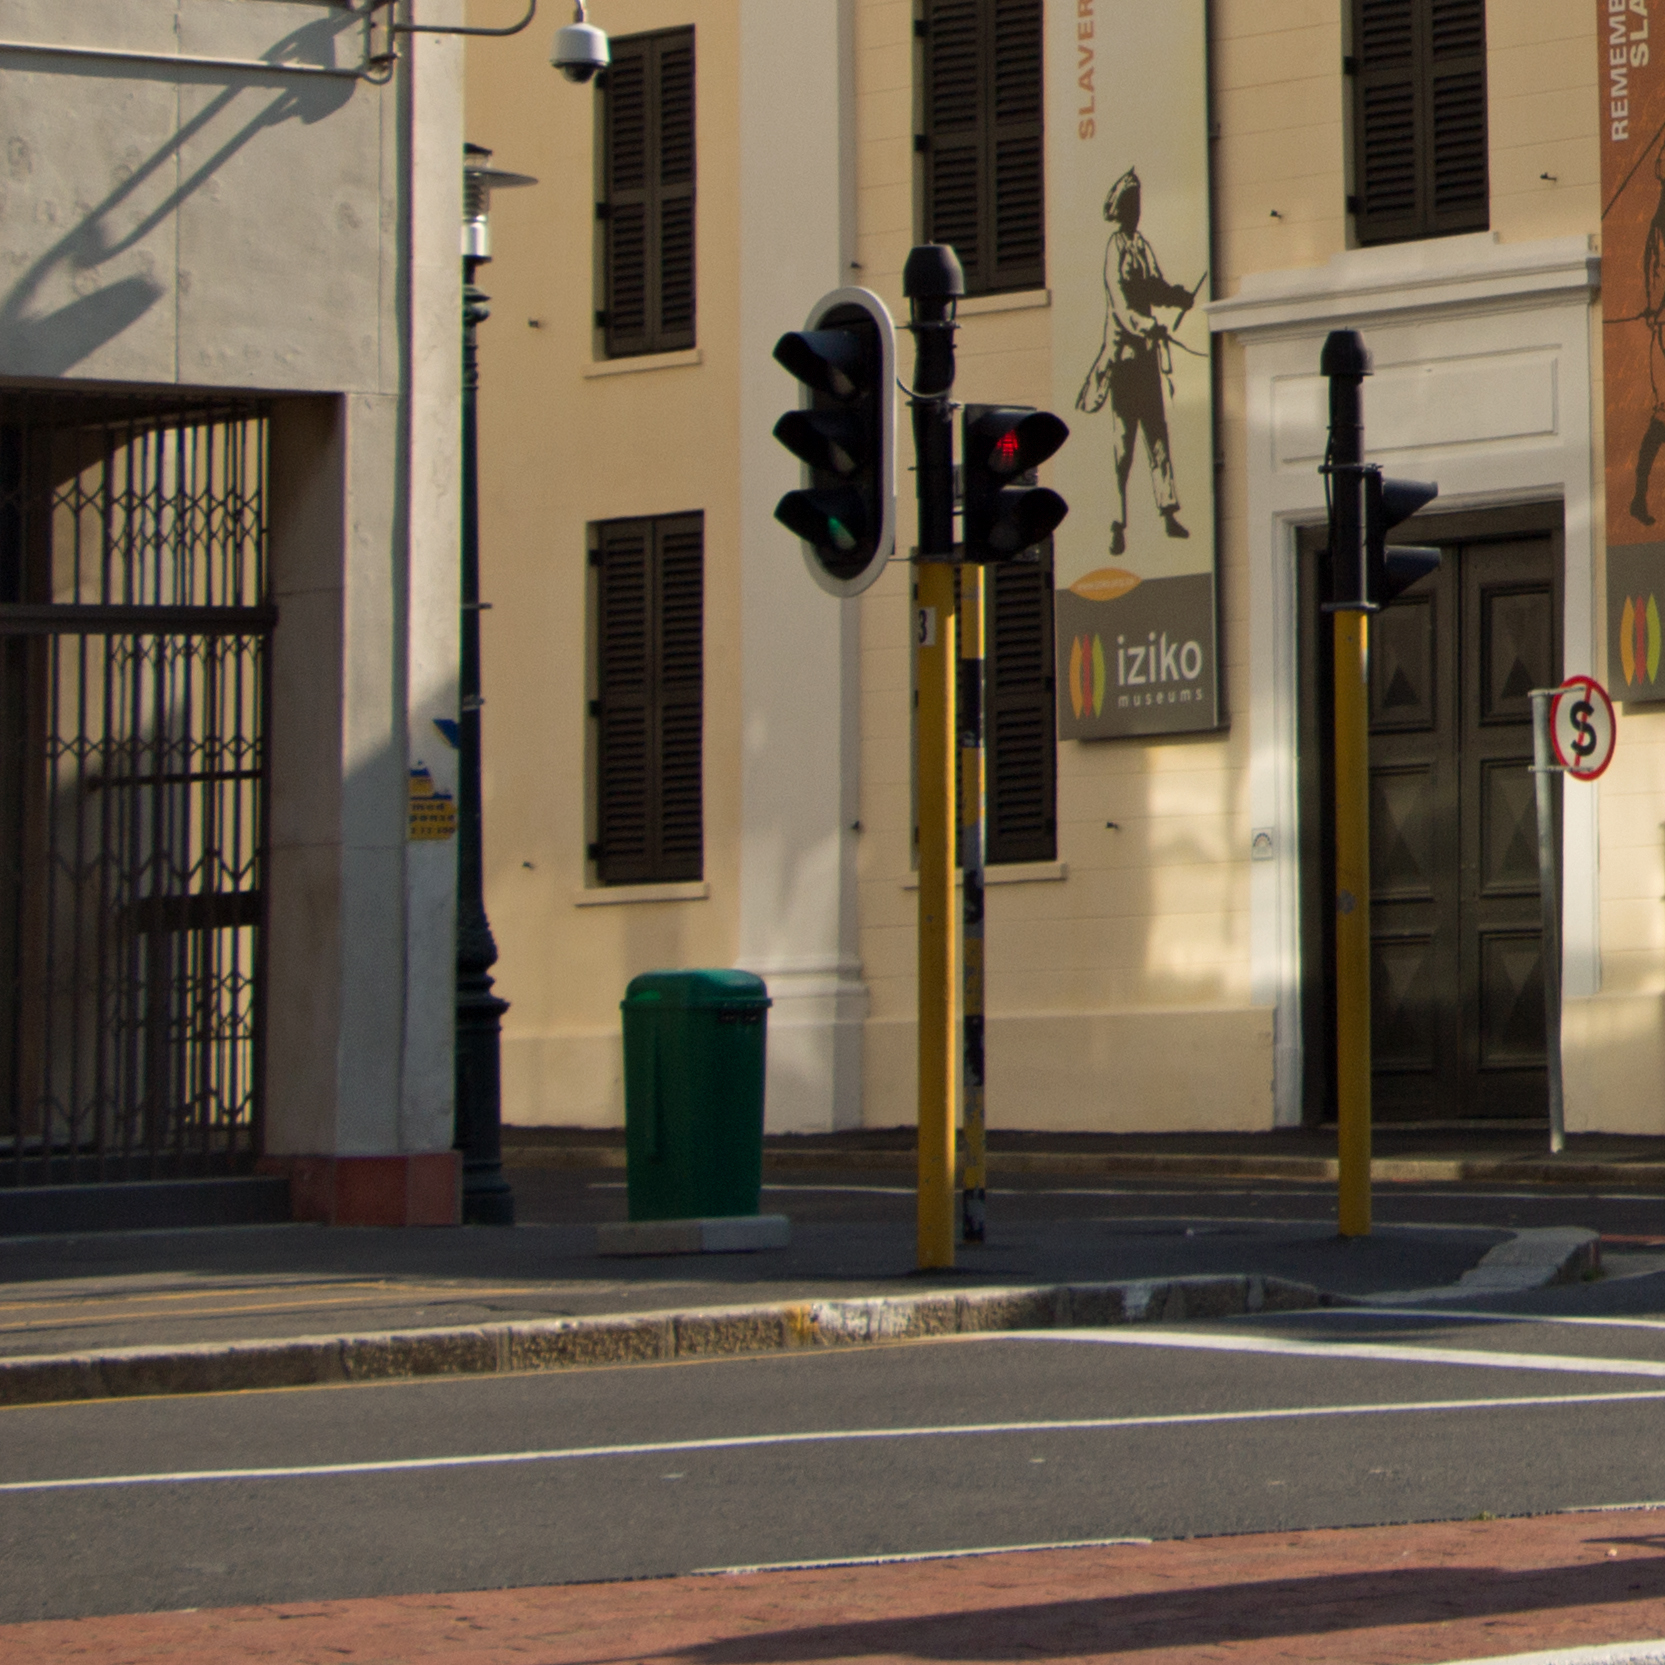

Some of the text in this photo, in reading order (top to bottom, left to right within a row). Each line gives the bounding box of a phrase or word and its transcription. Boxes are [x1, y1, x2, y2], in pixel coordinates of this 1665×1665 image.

[1117, 631, 1202, 686] iziko
[1118, 688, 1203, 708] museums
[1569, 700, 1597, 757] S
